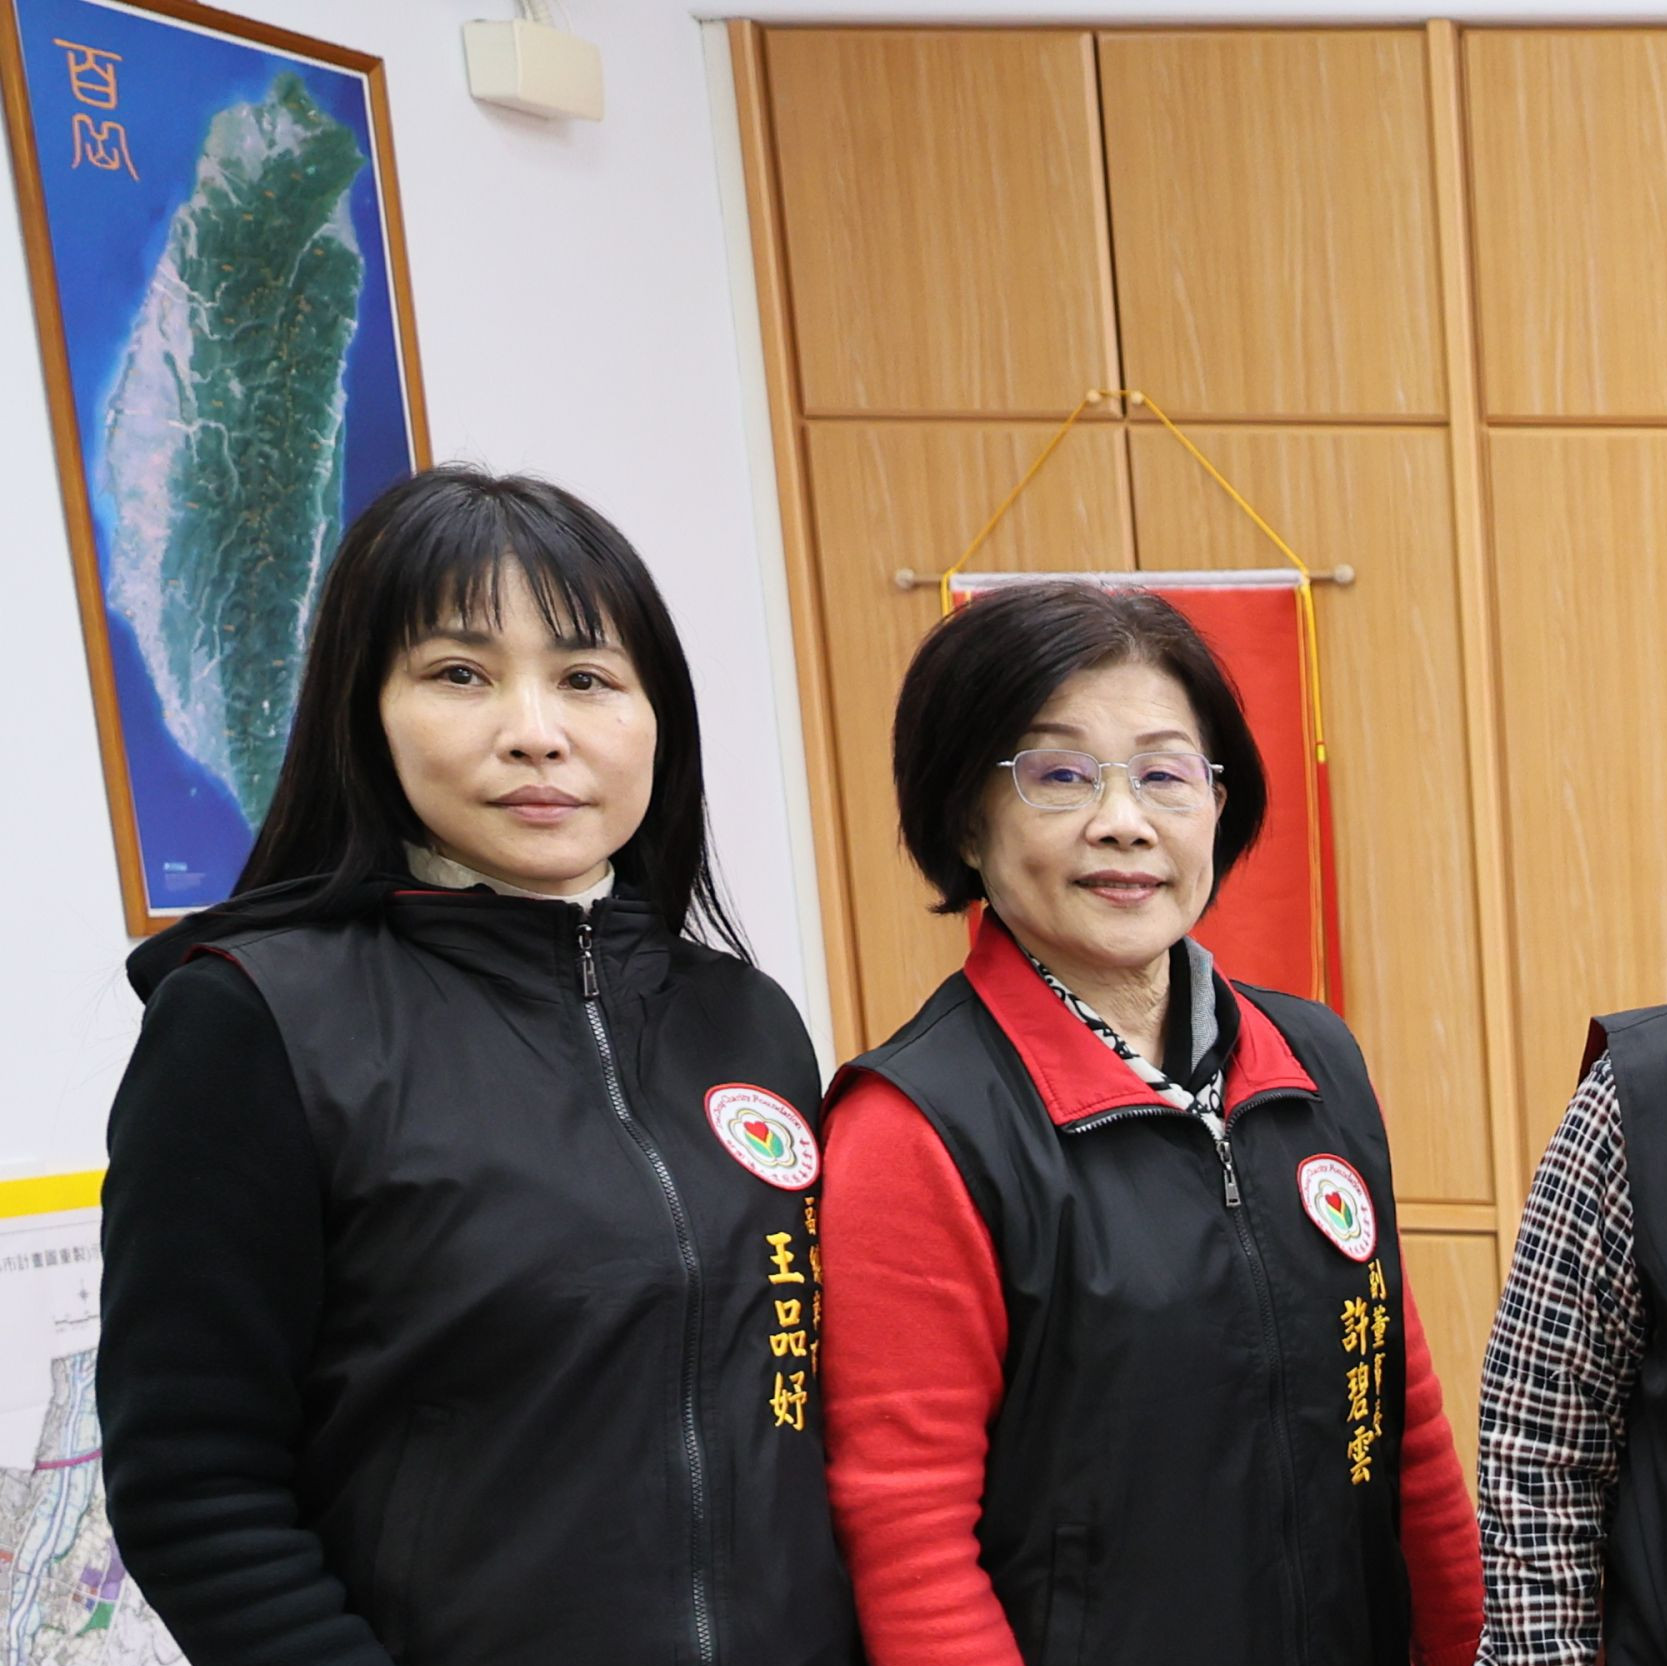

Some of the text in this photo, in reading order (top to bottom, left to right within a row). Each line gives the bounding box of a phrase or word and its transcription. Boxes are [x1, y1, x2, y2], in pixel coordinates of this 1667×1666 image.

[765, 1231, 808, 1432] 王品妤
[1340, 1296, 1374, 1485] 許碧雲
